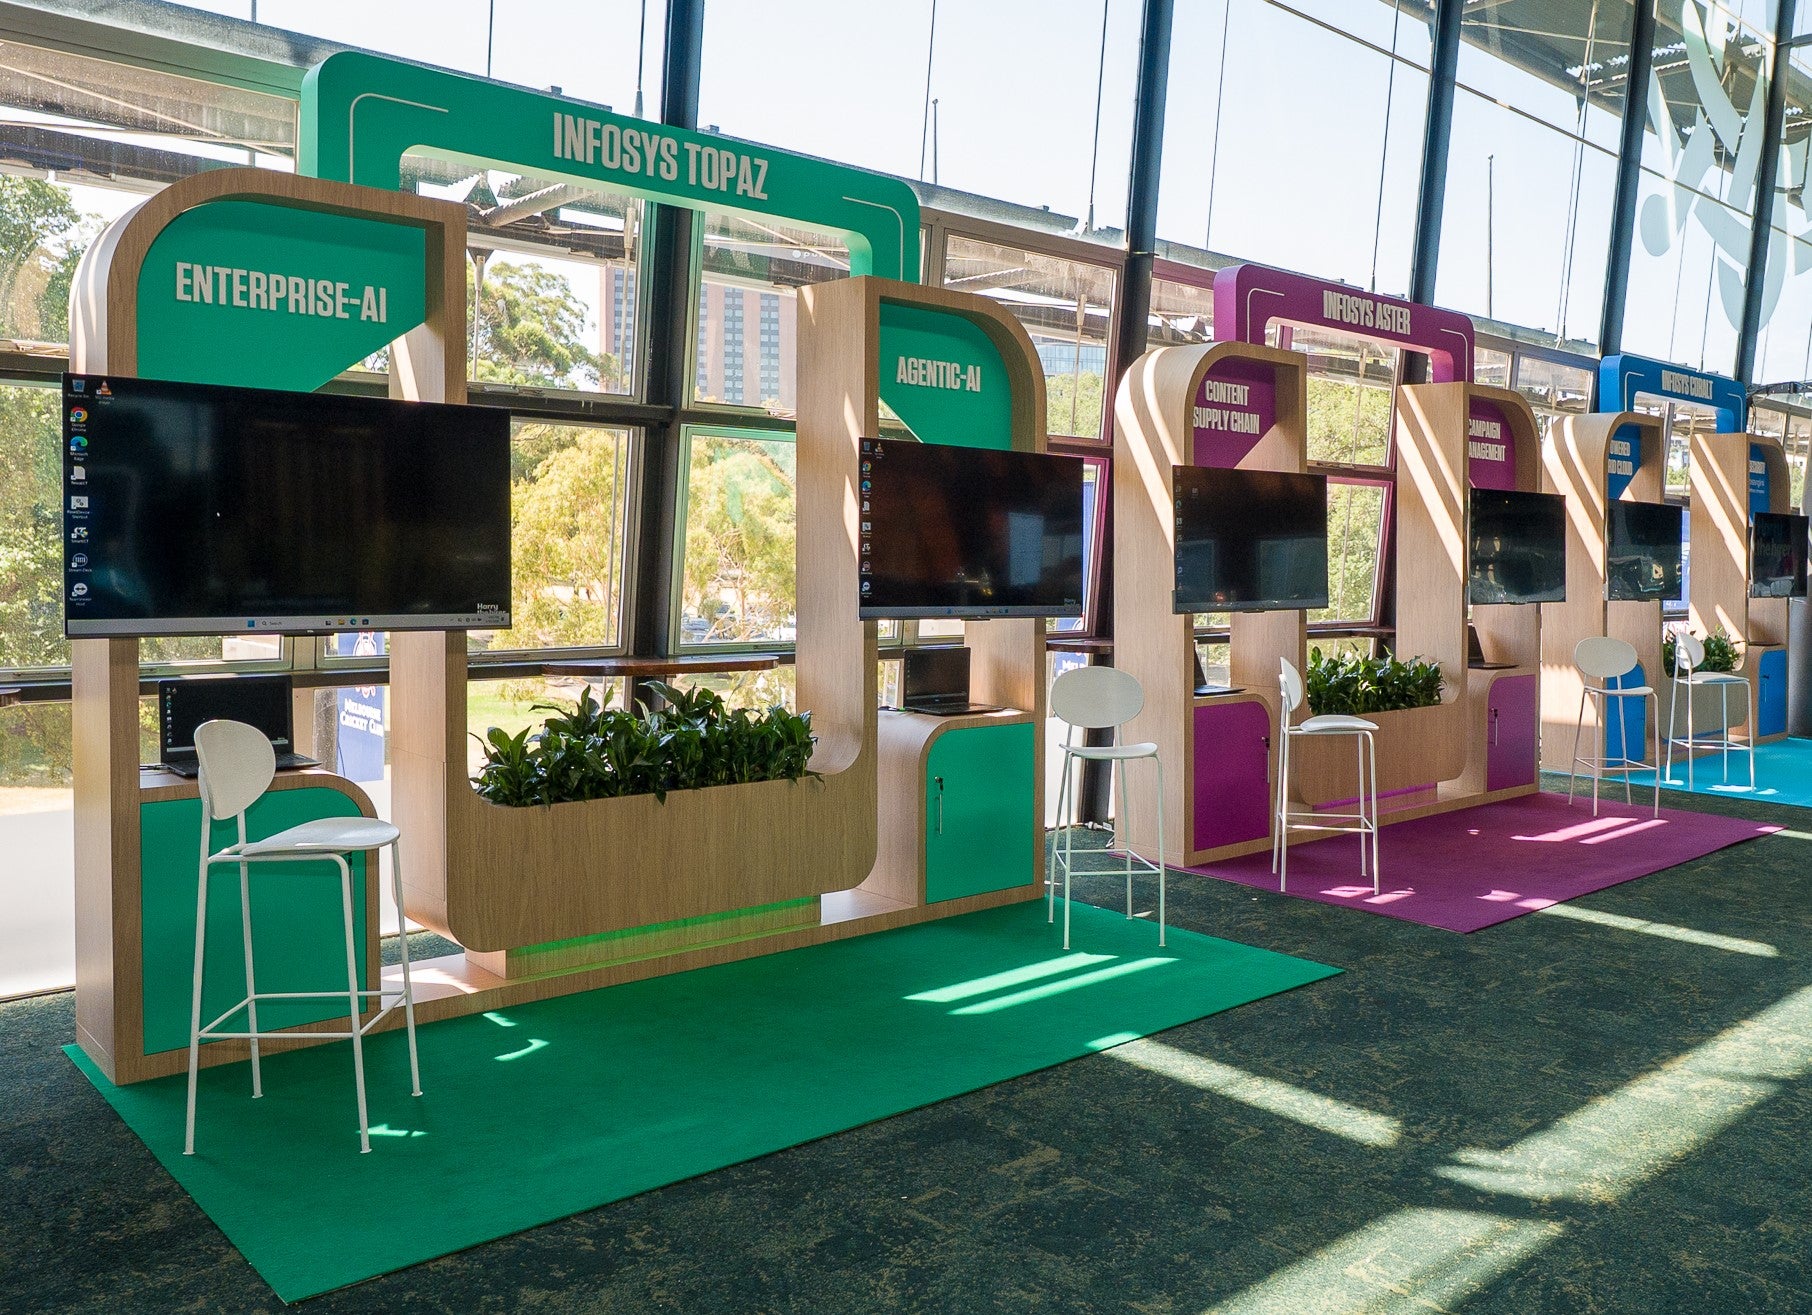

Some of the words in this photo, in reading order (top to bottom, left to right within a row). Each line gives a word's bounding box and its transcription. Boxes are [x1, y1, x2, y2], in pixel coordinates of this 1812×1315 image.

[553, 112, 678, 181] INFOSYS
[684, 142, 768, 200] TOPAZ
[176, 261, 387, 323] ENTERPRISE-AI
[1323, 290, 1374, 328] INFOSYS
[1375, 302, 1411, 335] ASTER
[896, 356, 981, 392] AGENTIC-AI
[1205, 380, 1250, 407] CONTENT
[1193, 406, 1230, 431] SUPPLY
[1230, 411, 1260, 435] CHAIN
[1468, 441, 1506, 462] ANAGEMENT
